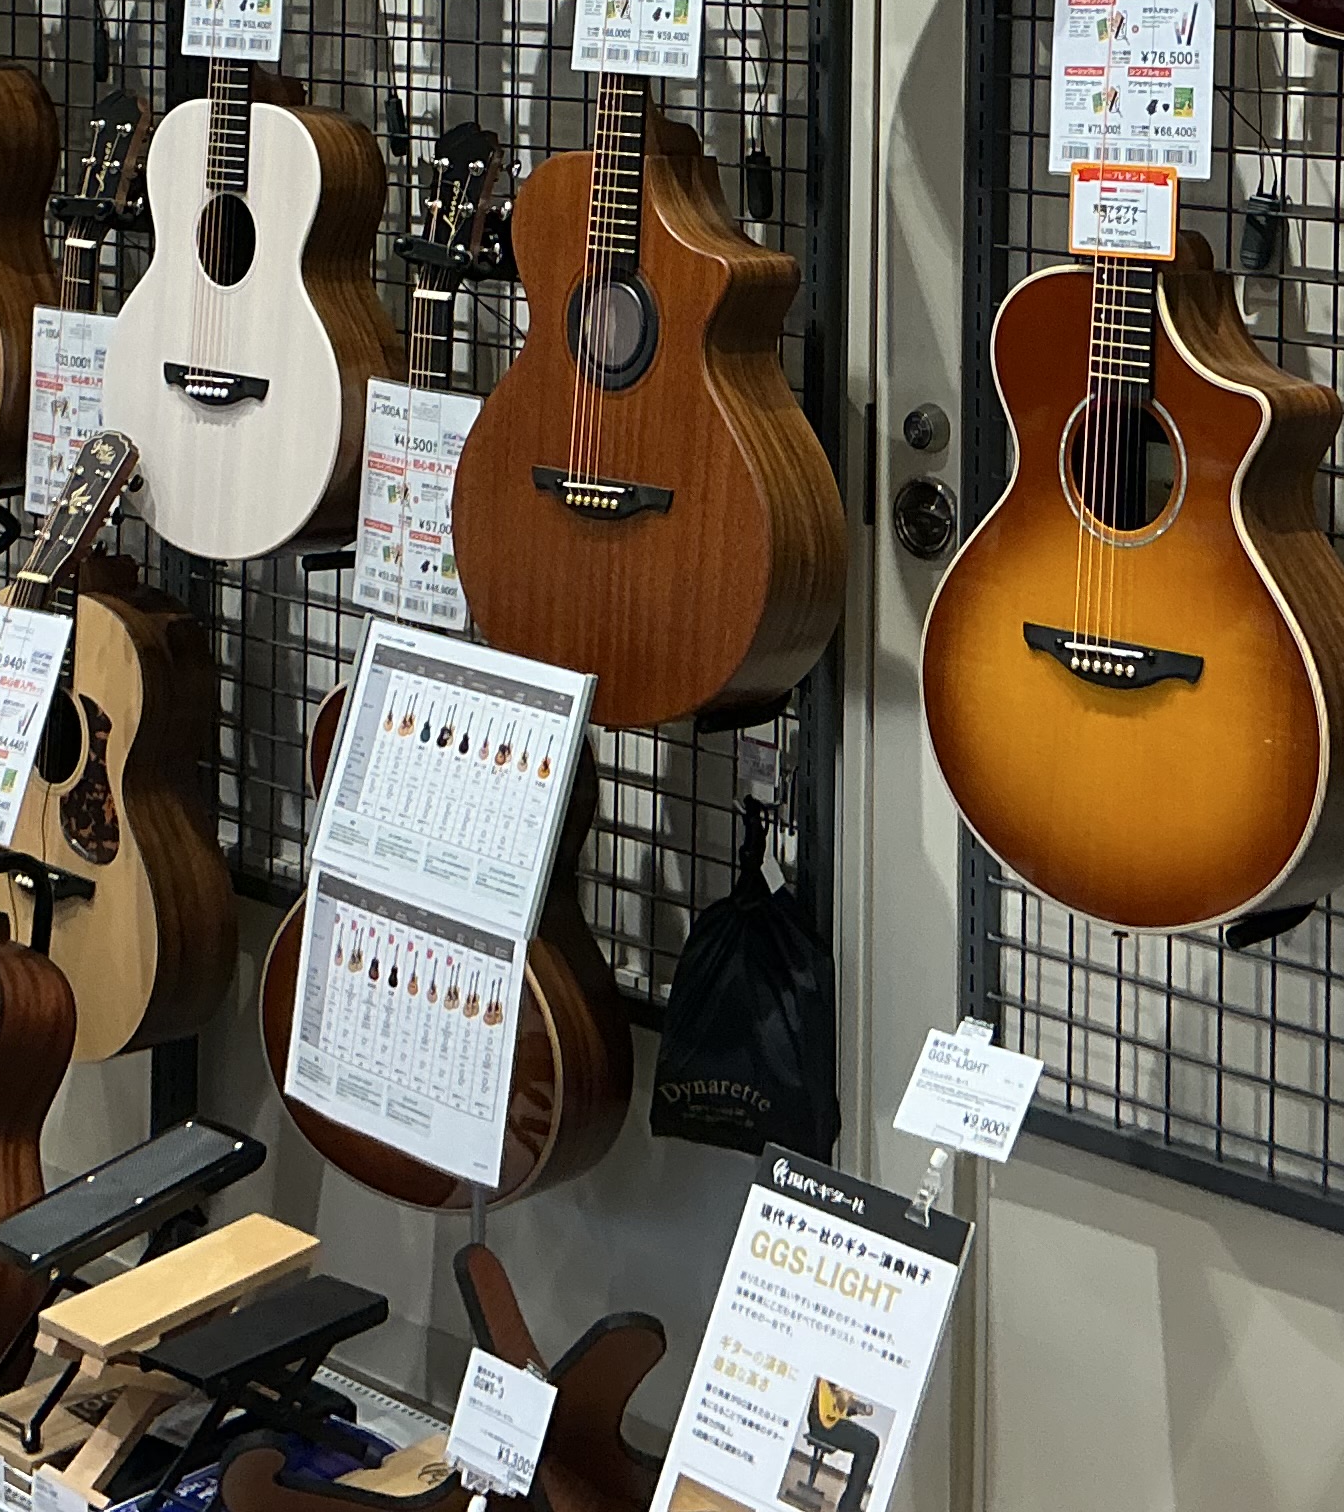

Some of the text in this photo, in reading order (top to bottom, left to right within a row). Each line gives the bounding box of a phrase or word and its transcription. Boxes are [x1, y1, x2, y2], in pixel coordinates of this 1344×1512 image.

[1140, 50, 1193, 66] ¥76,500
[659, 1079, 771, 1112] Dynarette
[750, 1230, 902, 1314] GGS-LIGHT
